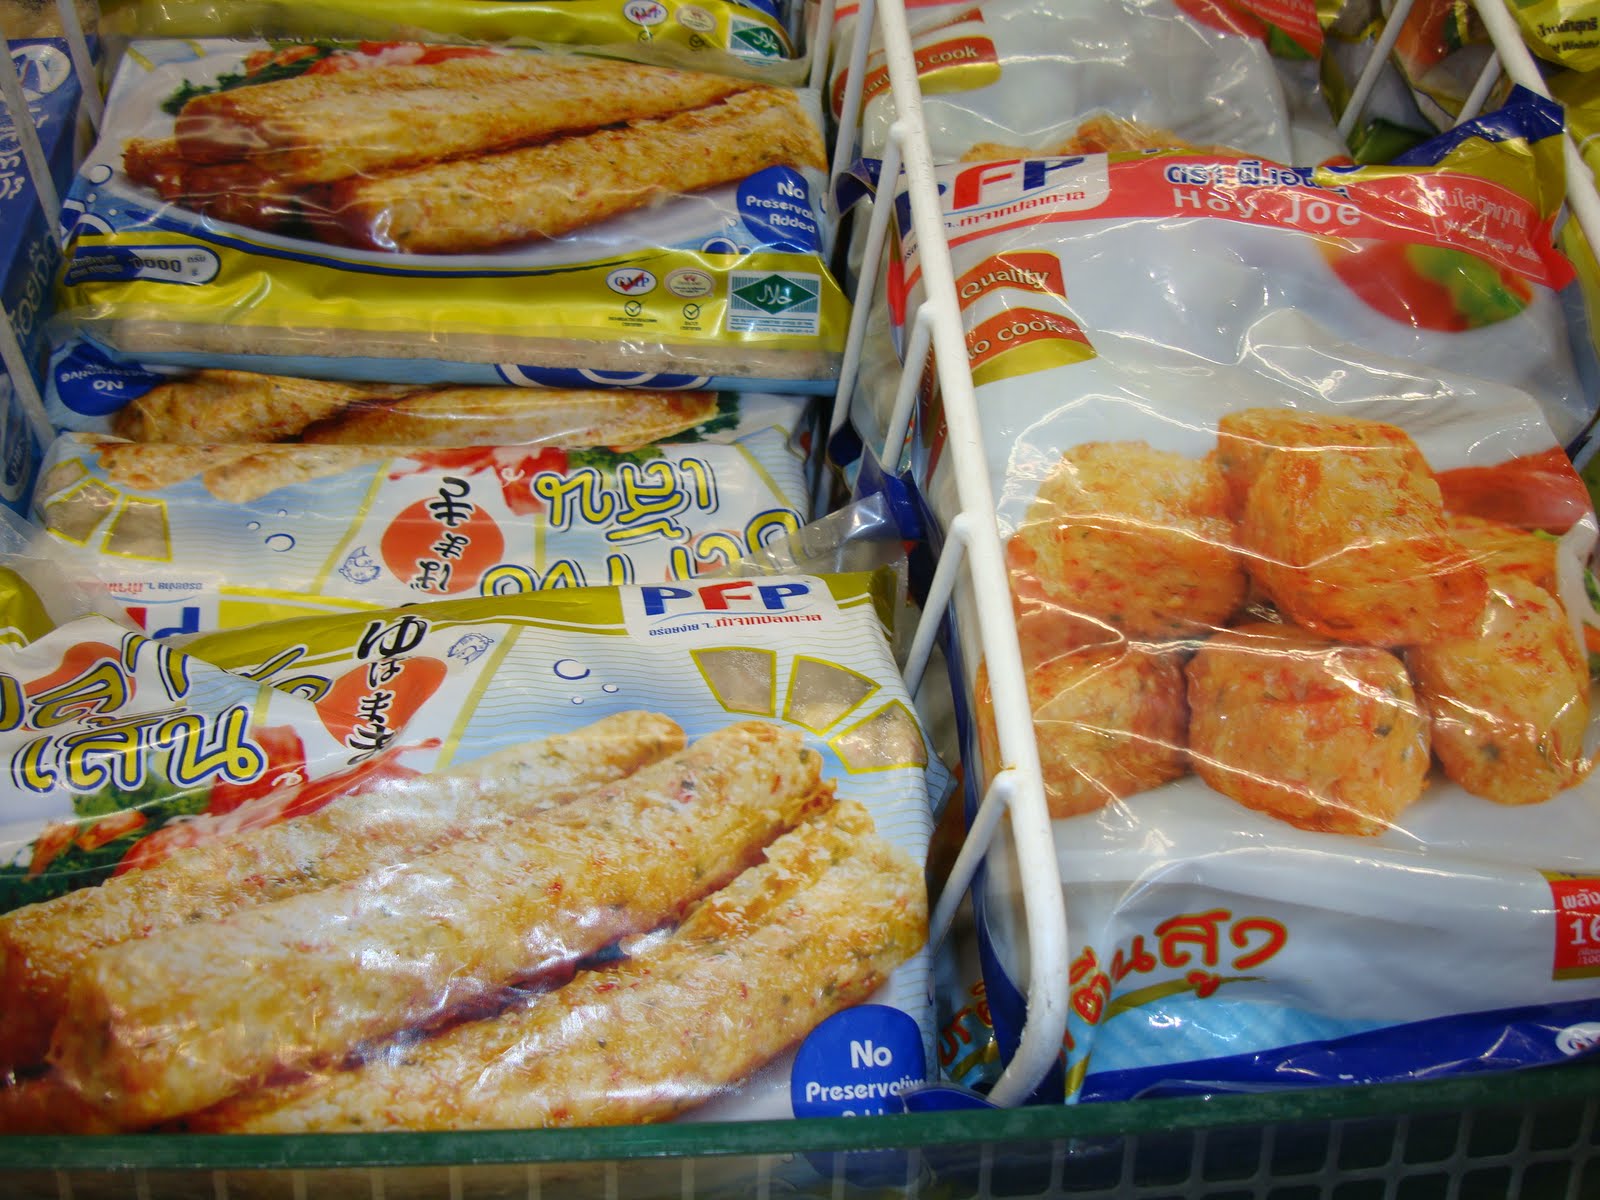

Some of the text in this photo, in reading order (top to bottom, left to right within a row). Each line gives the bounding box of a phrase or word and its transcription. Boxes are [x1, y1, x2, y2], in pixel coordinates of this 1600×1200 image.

[929, 45, 978, 64] cook
[777, 181, 806, 200] No
[1173, 188, 1361, 226] Hoy Joe
[769, 213, 816, 234] Added
[960, 268, 1050, 299] Quality
[997, 320, 1066, 342] cook
[533, 459, 713, 542] เส้น
[640, 580, 811, 616] PFP
[850, 1039, 893, 1069] No
